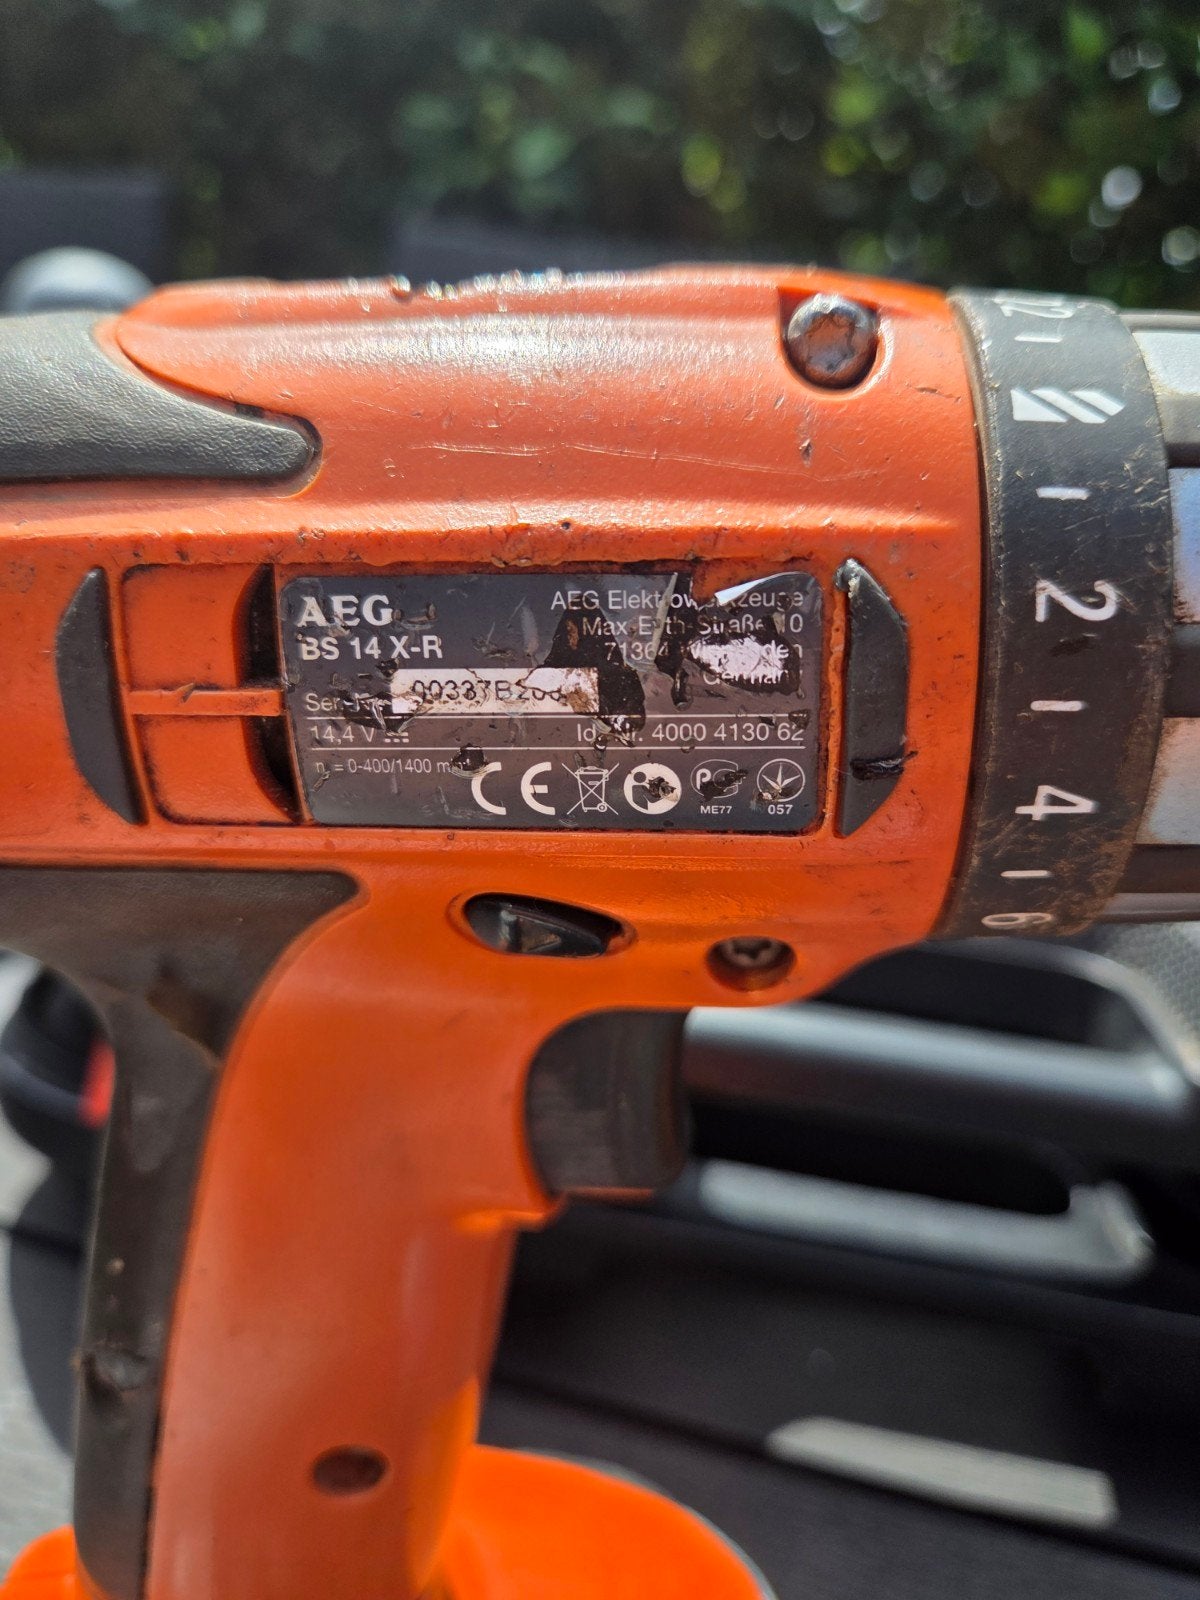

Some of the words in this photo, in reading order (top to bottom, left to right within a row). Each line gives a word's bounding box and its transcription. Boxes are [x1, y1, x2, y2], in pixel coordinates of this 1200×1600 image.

[551, 590, 600, 610] AEG
[1035, 580, 1118, 622] 2
[297, 594, 394, 627] AEG
[582, 616, 628, 636] Max
[301, 636, 340, 660] BS
[350, 637, 381, 660] 14
[390, 635, 443, 659] X-R
[310, 725, 355, 745] 14,4
[360, 725, 375, 742] V
[651, 723, 707, 742] 4000
[714, 722, 770, 742] 4130
[777, 722, 804, 742] 62
[347, 757, 432, 773] 0-400/1400
[700, 805, 732, 815] ME77
[767, 804, 793, 815] 057
[1015, 785, 1096, 820] 4
